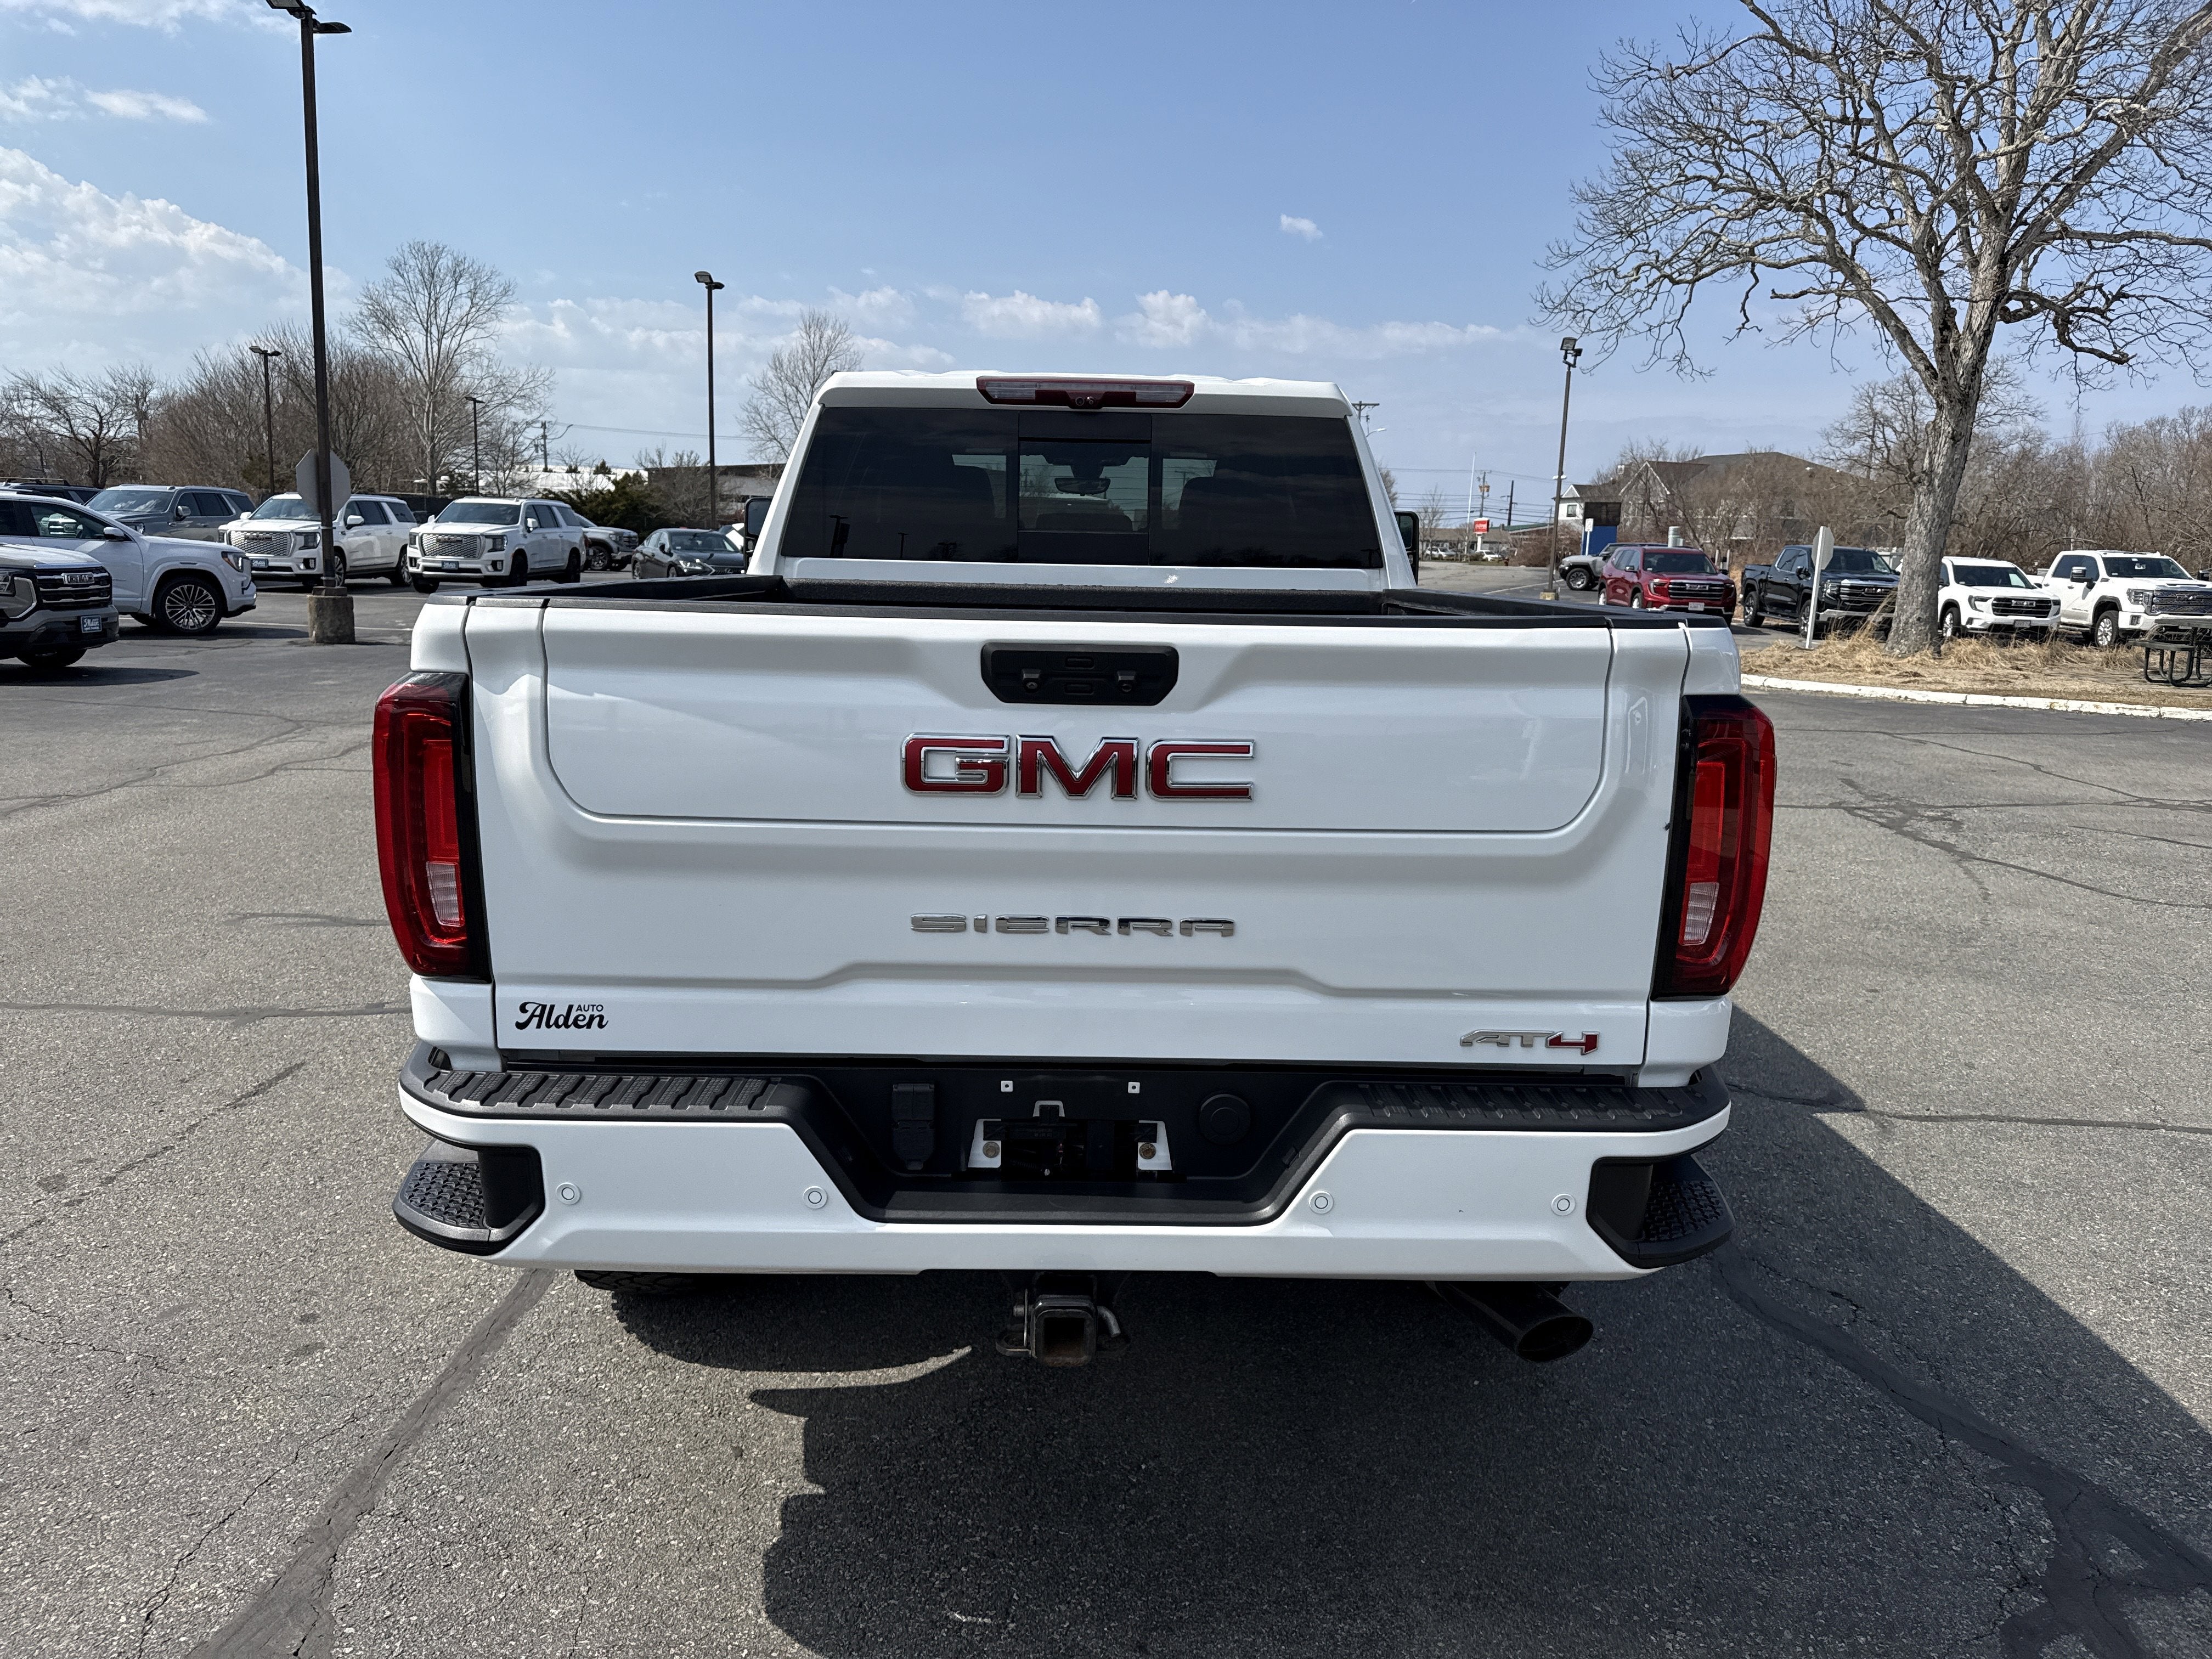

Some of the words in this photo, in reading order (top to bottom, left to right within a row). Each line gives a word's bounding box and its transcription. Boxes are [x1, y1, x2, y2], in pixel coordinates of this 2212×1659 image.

[900, 732, 1255, 802] GMC
[910, 913, 1235, 938] SIERRA
[515, 1001, 609, 1030] Alden
[1460, 1029, 1600, 1056] AT4
